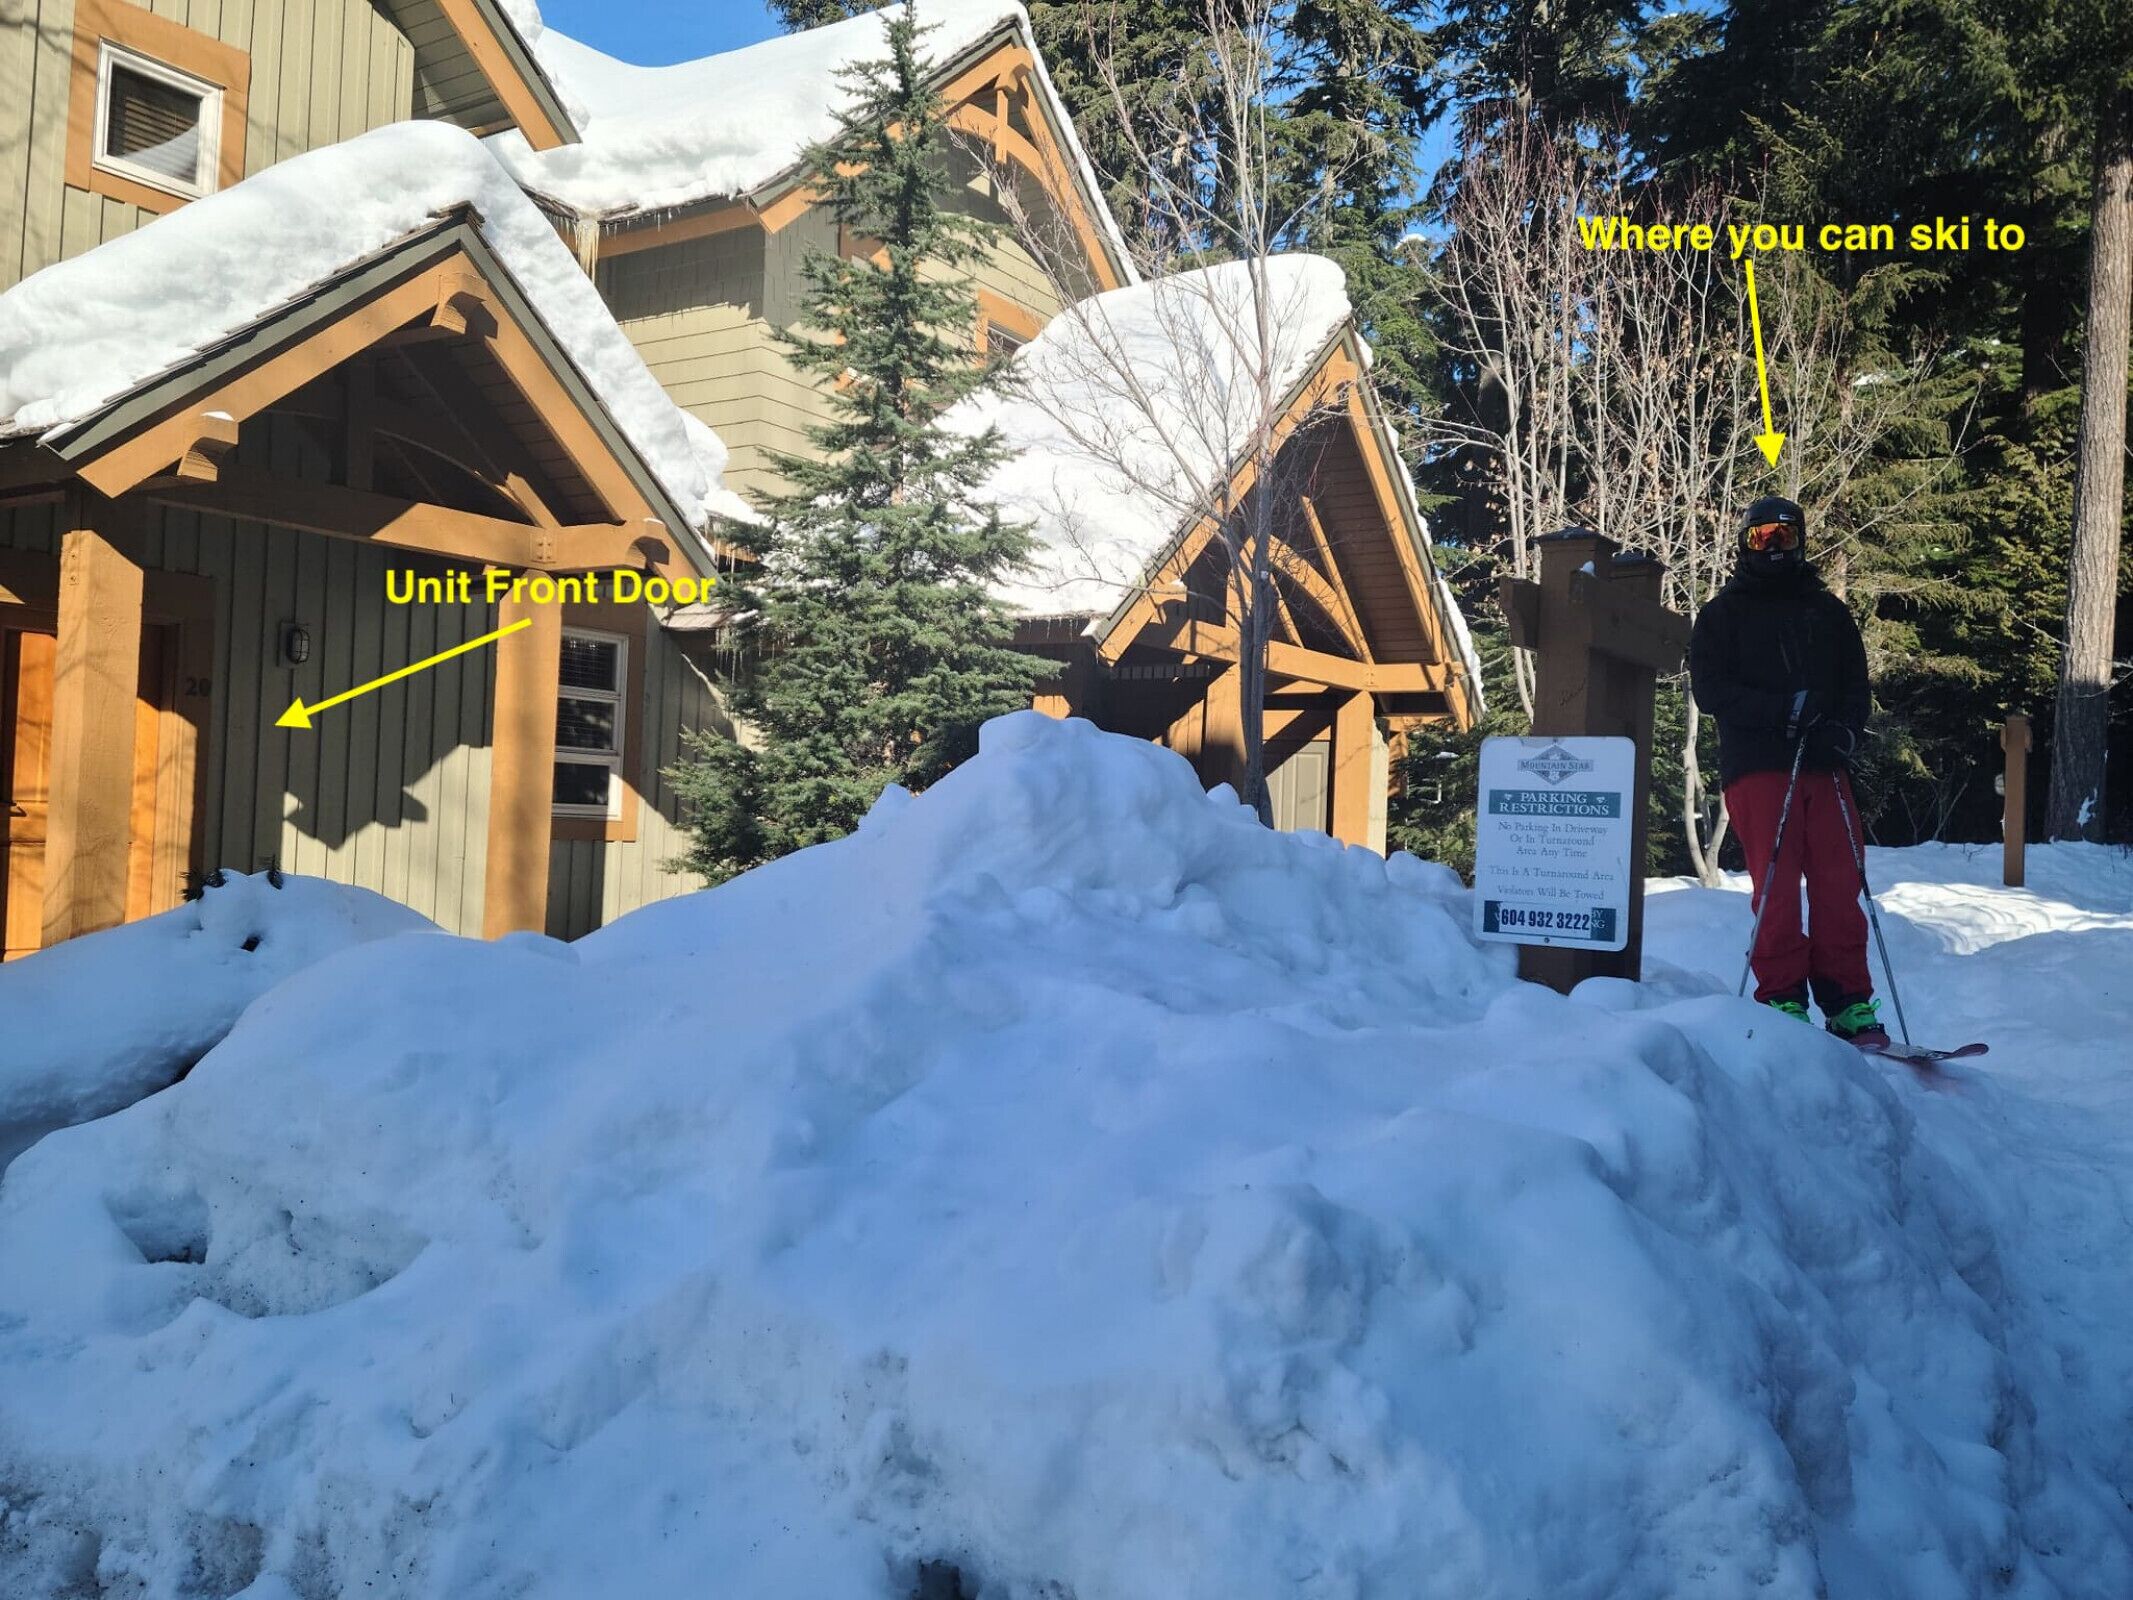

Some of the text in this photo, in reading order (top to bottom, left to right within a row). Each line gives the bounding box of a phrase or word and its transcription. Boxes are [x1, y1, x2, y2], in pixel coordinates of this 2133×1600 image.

[184, 676, 212, 697] 20
[1521, 792, 1588, 803] PARKING
[1499, 802, 1610, 816] RESTRICTIONS
[1498, 821, 1608, 835] No Parking In Driveway
[1510, 833, 1595, 846] Or In Turnaround
[1516, 846, 1588, 859] Area Any Time
[1489, 865, 1615, 881] This Is A Turnaround Area
[1497, 885, 1605, 900] Violators Will Be Towed
[1501, 908, 1526, 926] 604
[1528, 910, 1553, 928] 932
[1556, 912, 1591, 931] 3222
